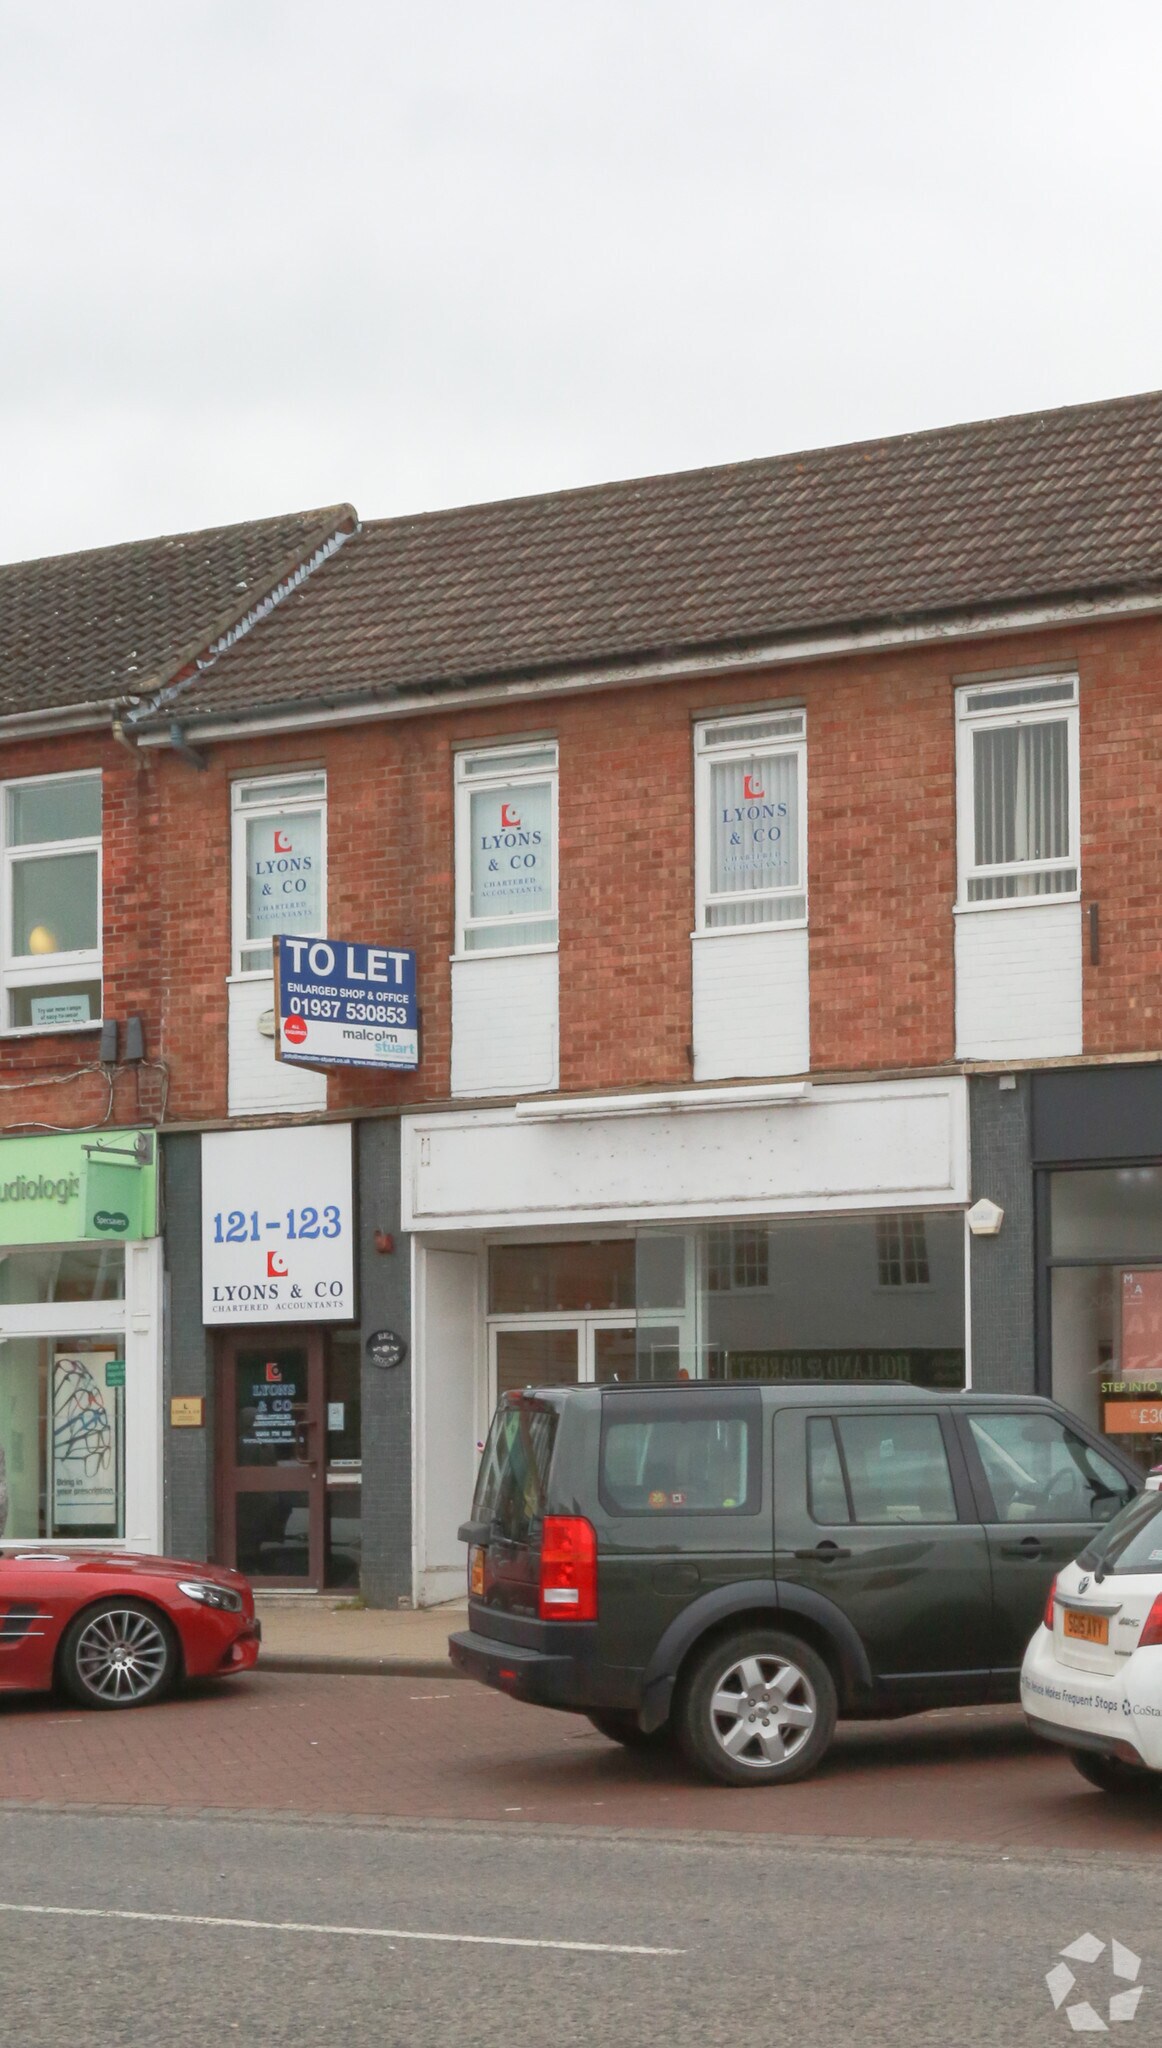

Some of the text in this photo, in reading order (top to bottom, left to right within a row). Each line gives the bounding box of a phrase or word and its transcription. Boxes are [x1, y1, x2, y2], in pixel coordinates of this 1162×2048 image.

[723, 803, 787, 823] LYONS
[481, 831, 541, 850] LYONS
[729, 826, 781, 845] & CO
[256, 856, 312, 875] LYONS
[488, 853, 536, 871] & CO
[262, 878, 307, 896] & CO
[481, 886, 543, 897] ACCOUNTANTS
[484, 877, 536, 889] CHARTERED
[258, 901, 306, 912] CHARTERED
[286, 940, 410, 984] TO LET
[287, 982, 409, 1004] ENLARGED SHOP & OFFICE
[290, 997, 407, 1024] 01937 530853
[342, 1029, 398, 1043] malcolm
[375, 1041, 415, 1054] stuart
[0, 1172, 79, 1204] udiologis
[96, 1215, 126, 1226] Specsavers
[214, 1205, 341, 1243] 121-123
[212, 1281, 343, 1301] LYONS & CO
[212, 1300, 344, 1312] CHARTERED ACCOUNTANTS
[252, 1384, 296, 1396] LYONS
[1101, 1381, 1158, 1393] STEP INTO
[272, 1400, 292, 1412] CO
[1062, 1690, 1093, 1707] Frequent
[1095, 1695, 1118, 1713] Stops
[1133, 1704, 1162, 1717] CoSta
